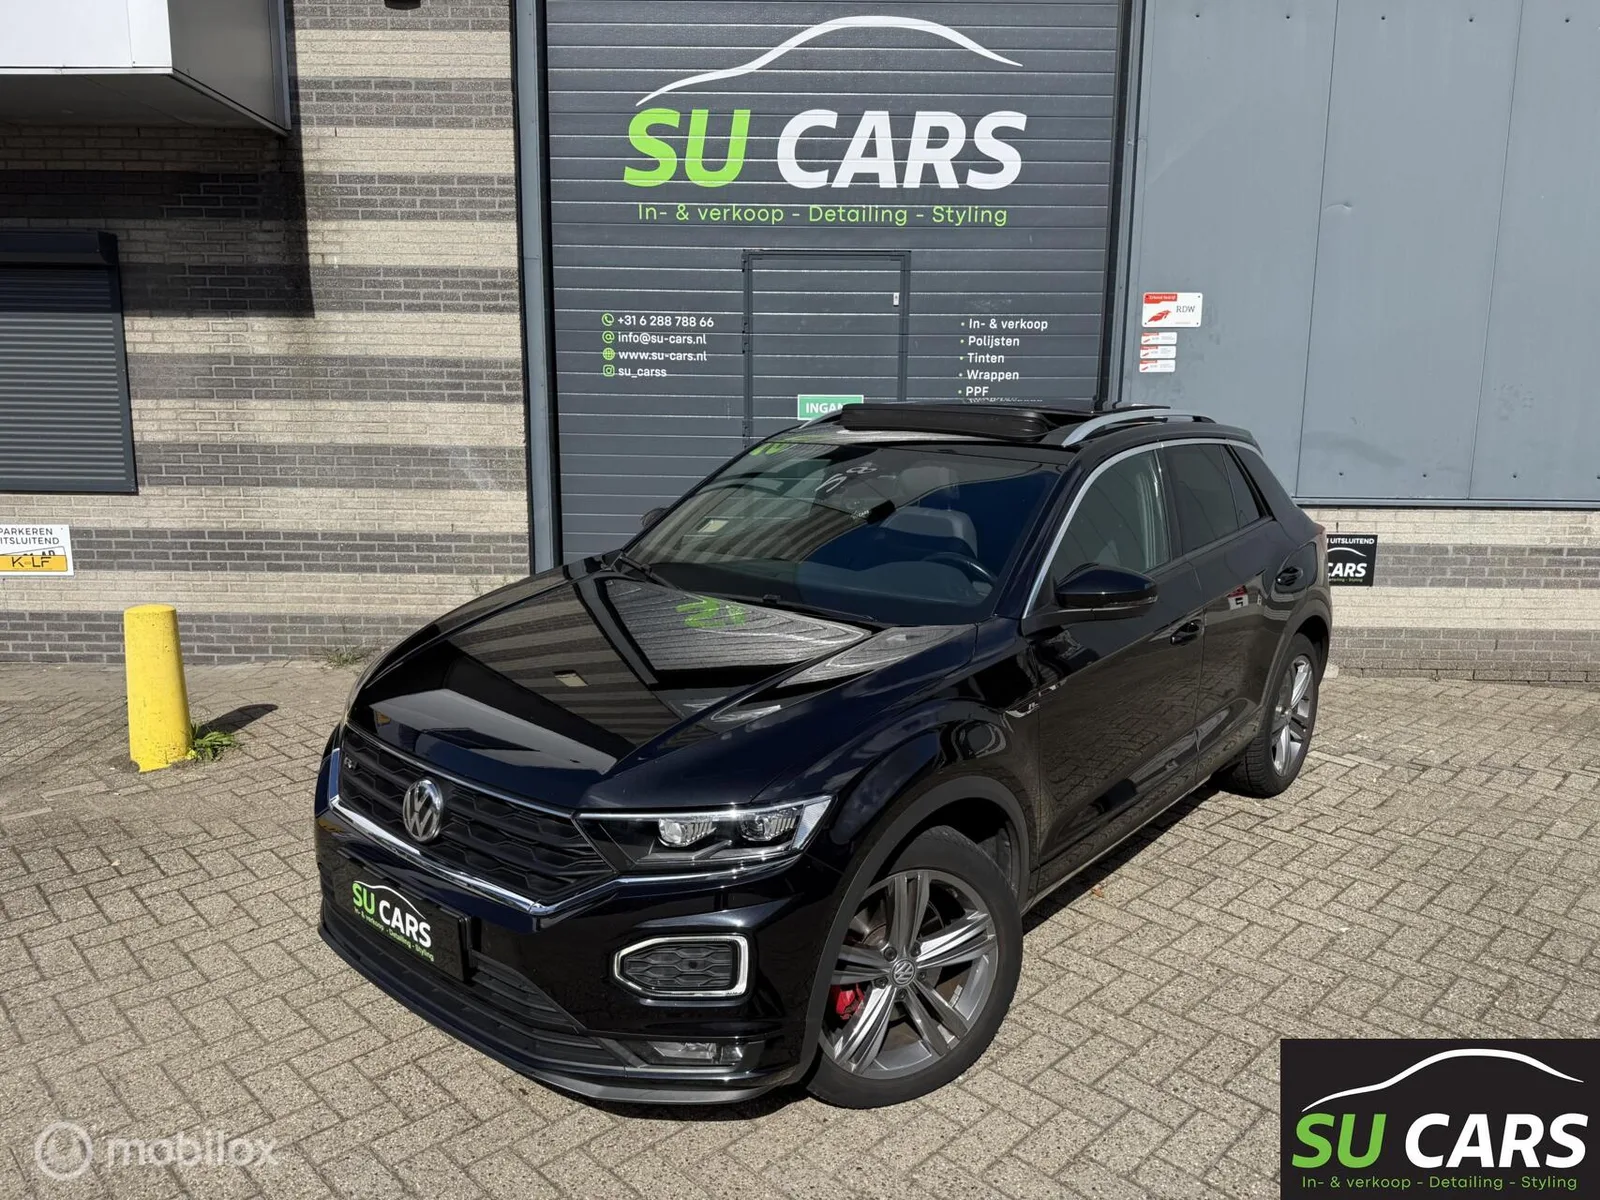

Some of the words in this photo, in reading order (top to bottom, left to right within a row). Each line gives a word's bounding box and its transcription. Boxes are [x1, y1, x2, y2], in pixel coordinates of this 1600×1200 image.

[623, 108, 751, 188] SU
[777, 109, 1028, 190] CARS
[638, 204, 667, 220] In-
[676, 205, 689, 221] &
[699, 205, 784, 224] verkoop
[809, 205, 907, 226] Detailing
[932, 206, 1008, 227] Styling
[1176, 305, 1195, 313] RDW
[618, 315, 636, 326] +31
[640, 316, 647, 326] 6
[650, 316, 672, 327] 288
[675, 316, 697, 327] 788
[699, 317, 714, 328] 66
[969, 318, 985, 329] In-
[989, 318, 998, 329] &
[1001, 318, 1048, 331] verkoop
[618, 332, 707, 344] info@su-cars.nl
[968, 336, 1020, 348] Polijsten
[618, 351, 707, 361] www.su-cars.nl
[967, 353, 1005, 363] Tinten
[618, 367, 667, 378] su_carss
[966, 369, 1020, 382] Wrappen
[965, 386, 989, 397] PPF
[0, 536, 60, 545] ITSLUITEND
[1330, 537, 1375, 545] UITSLUITEND
[352, 882, 375, 915] SU
[378, 899, 432, 949] CARS
